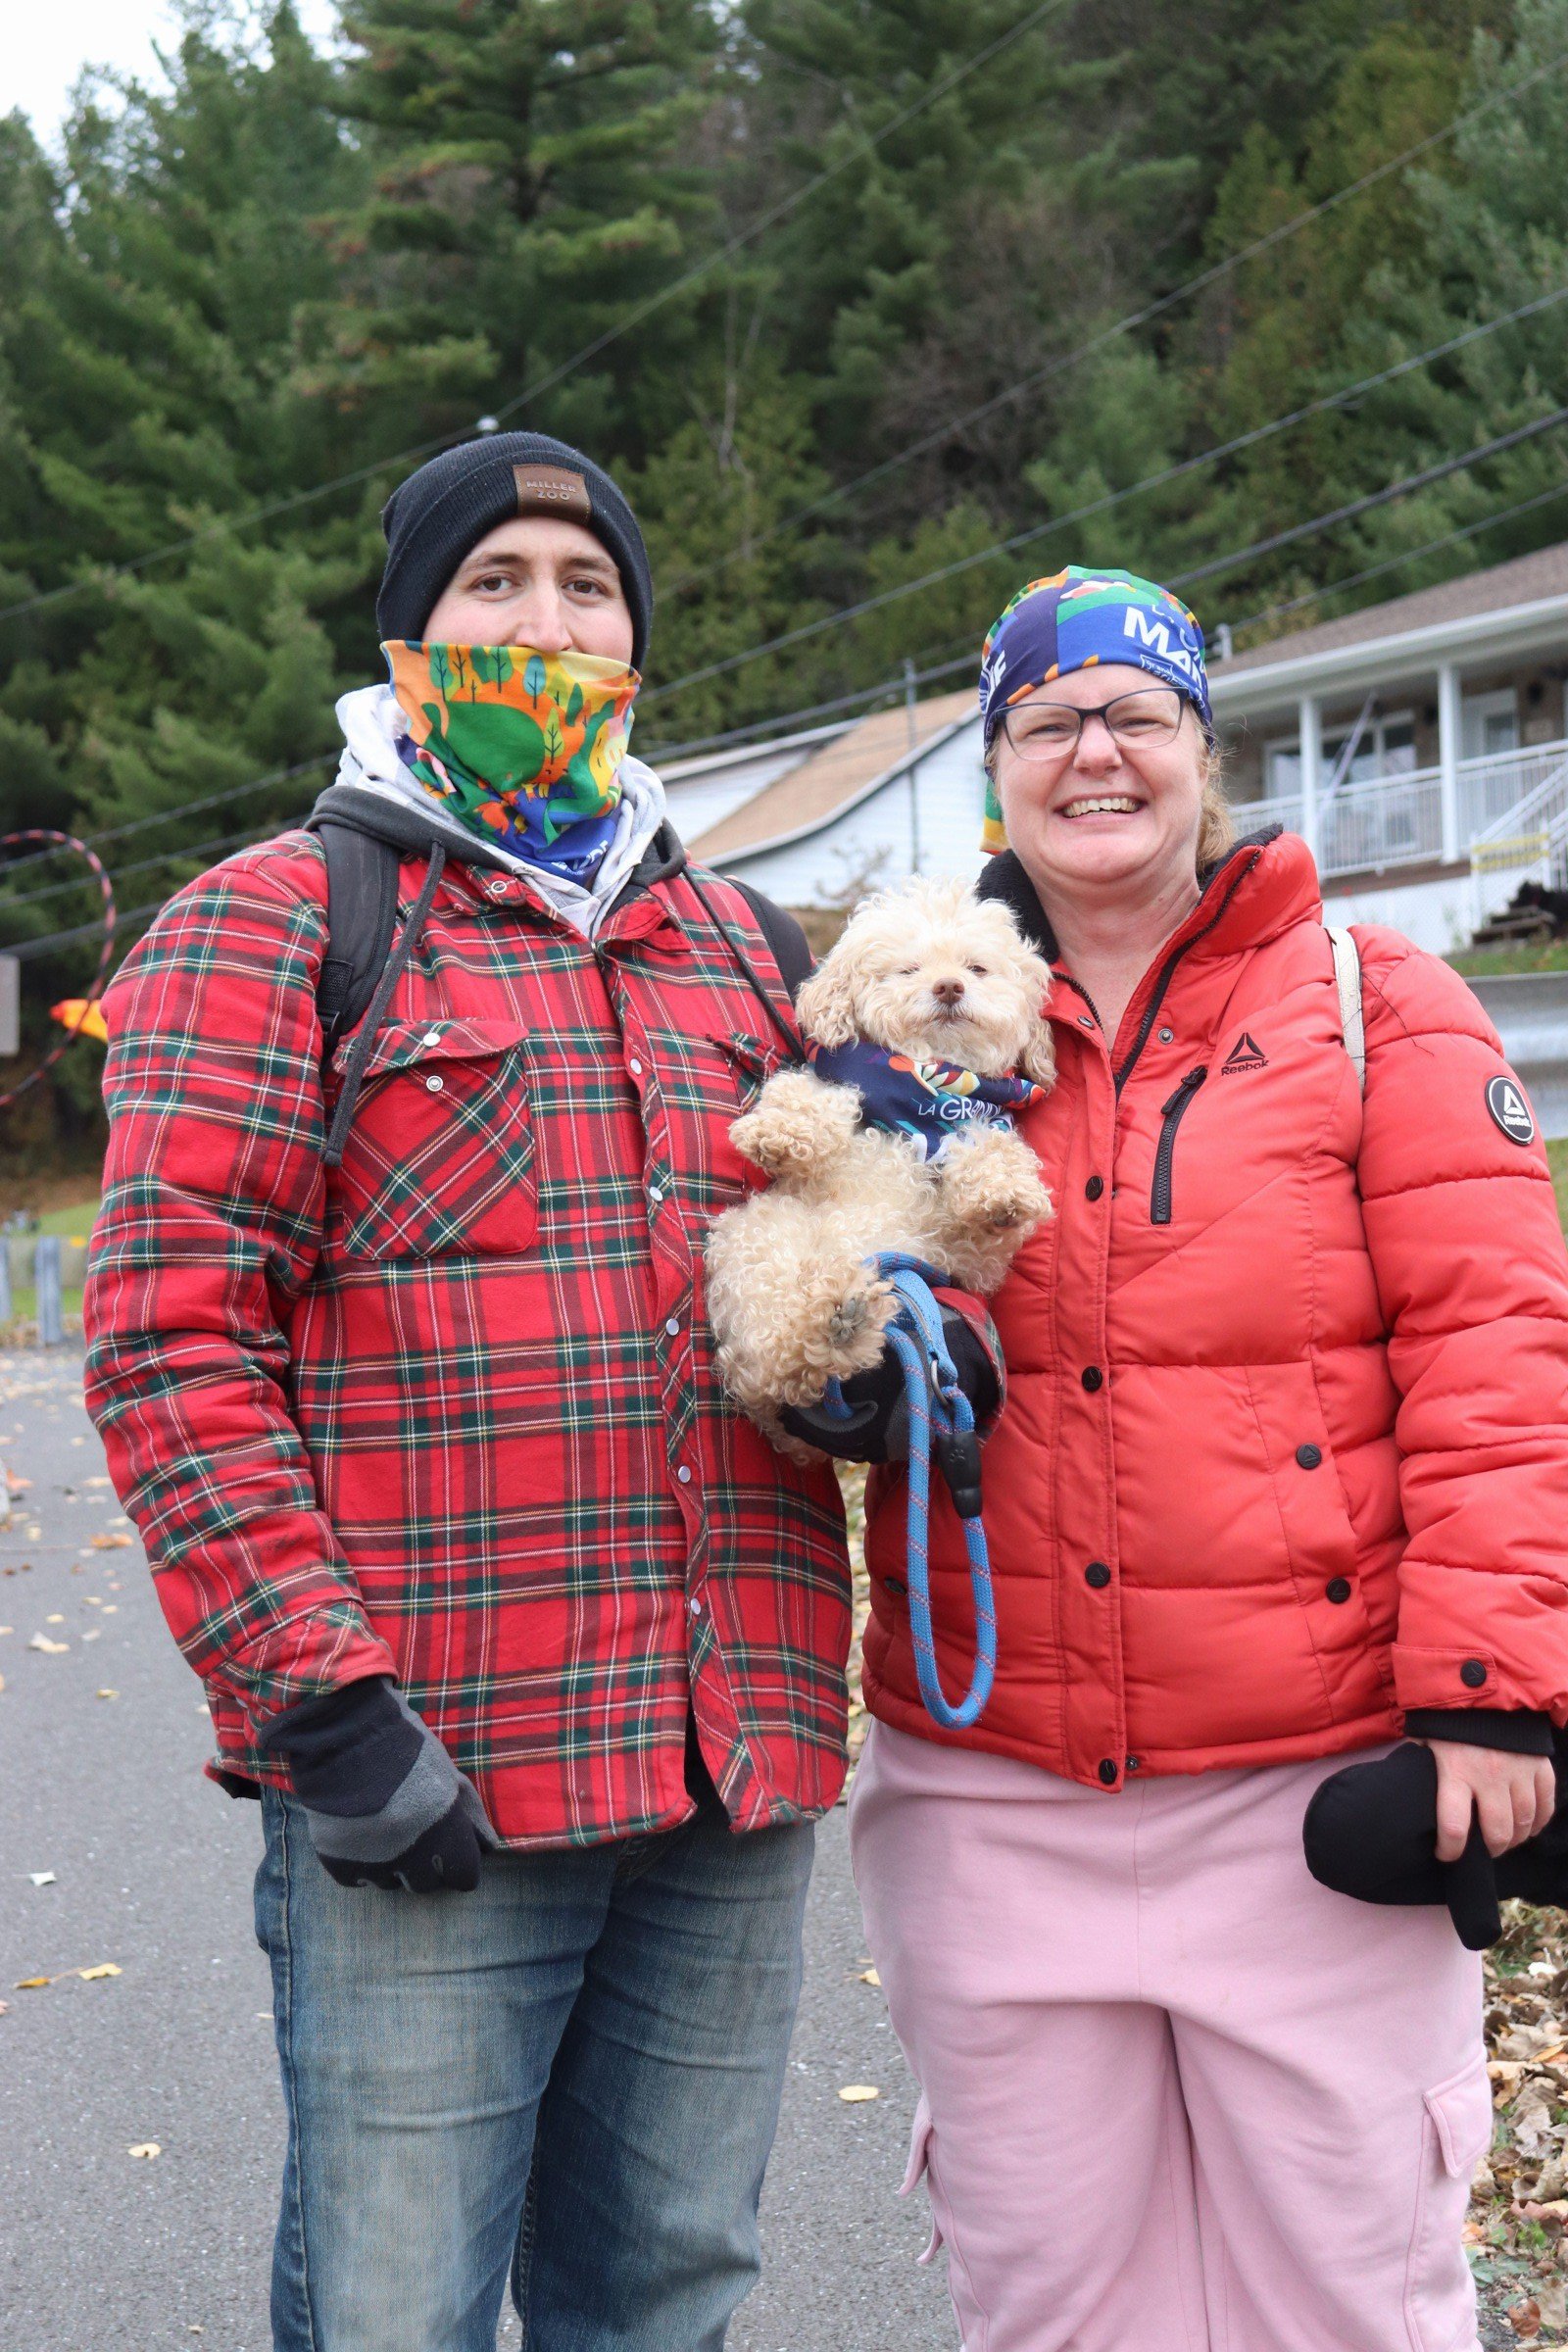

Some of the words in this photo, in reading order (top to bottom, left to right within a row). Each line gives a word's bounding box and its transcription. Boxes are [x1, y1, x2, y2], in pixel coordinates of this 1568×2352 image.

[526, 480, 576, 492] MILLER
[537, 491, 570, 501] ZOO
[1221, 1059, 1269, 1076] Reebok
[918, 1103, 935, 1116] LA
